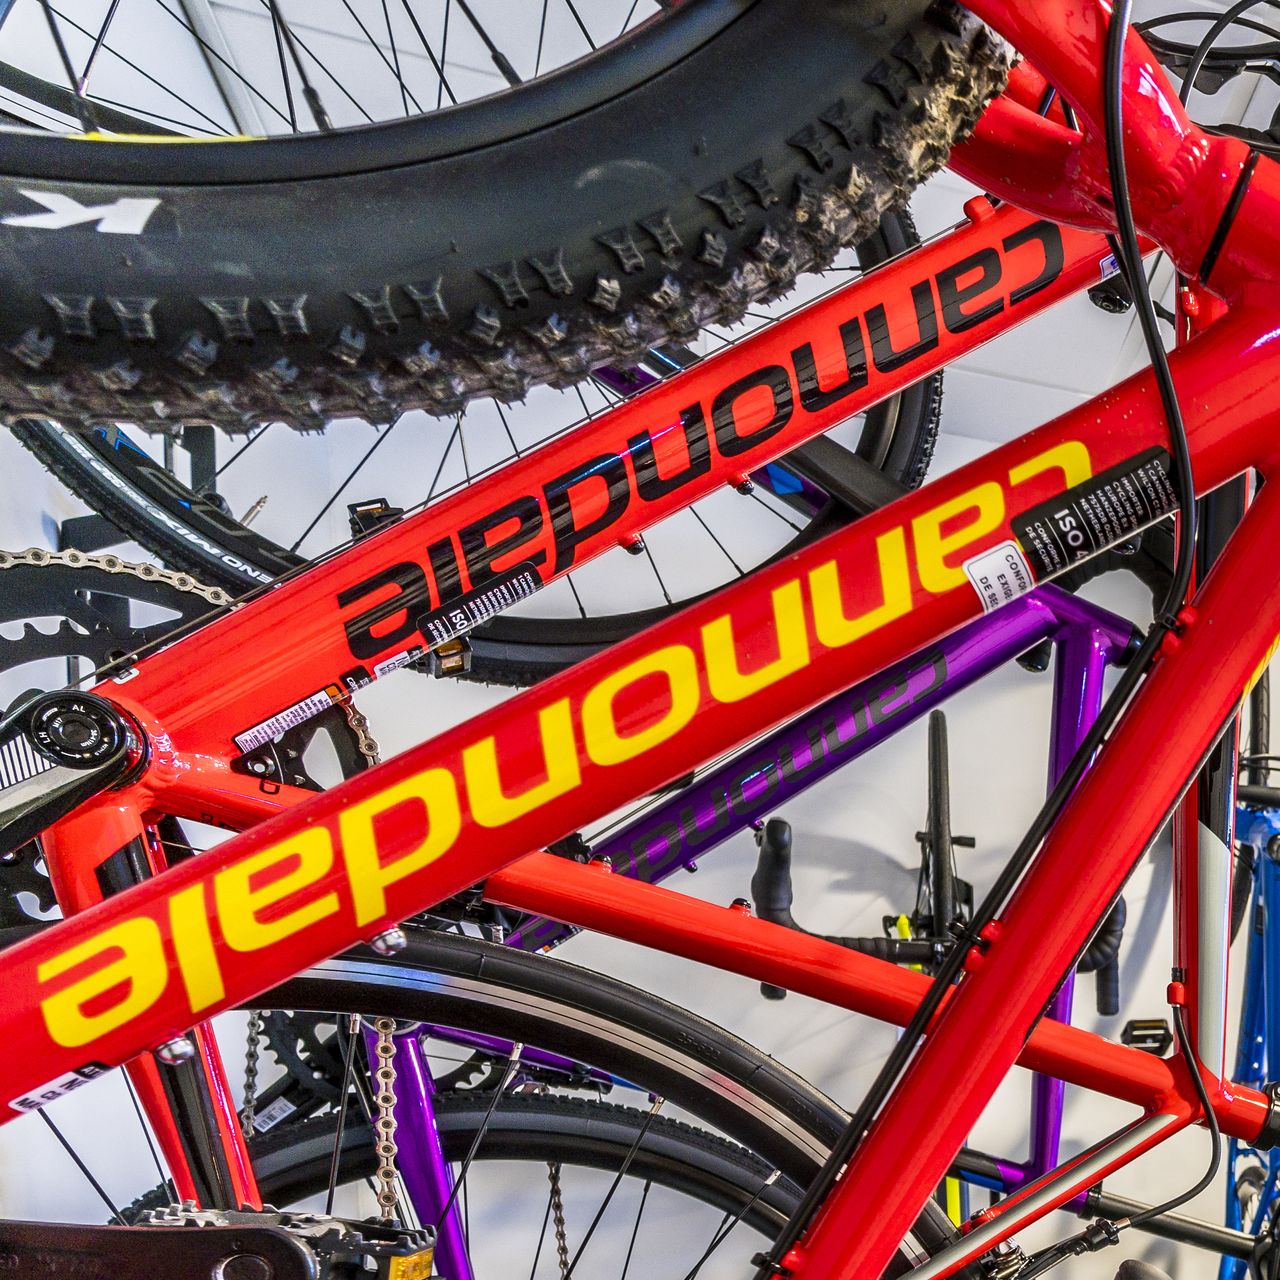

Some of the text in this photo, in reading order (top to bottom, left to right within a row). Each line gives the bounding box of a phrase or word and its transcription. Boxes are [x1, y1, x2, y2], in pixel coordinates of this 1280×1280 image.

[338, 220, 1064, 661] cannondale
[1136, 467, 1157, 500] WILTON
[1152, 459, 1174, 494] CYCLING
[1103, 484, 1125, 518] EUROPE
[1111, 480, 1133, 515] CYCLING
[1025, 525, 1036, 539] DE
[1053, 507, 1085, 549] ISO
[979, 576, 992, 592] DE
[449, 609, 467, 630] ISO
[38, 731, 51, 744] LH
[38, 440, 1093, 1049] cannondale
